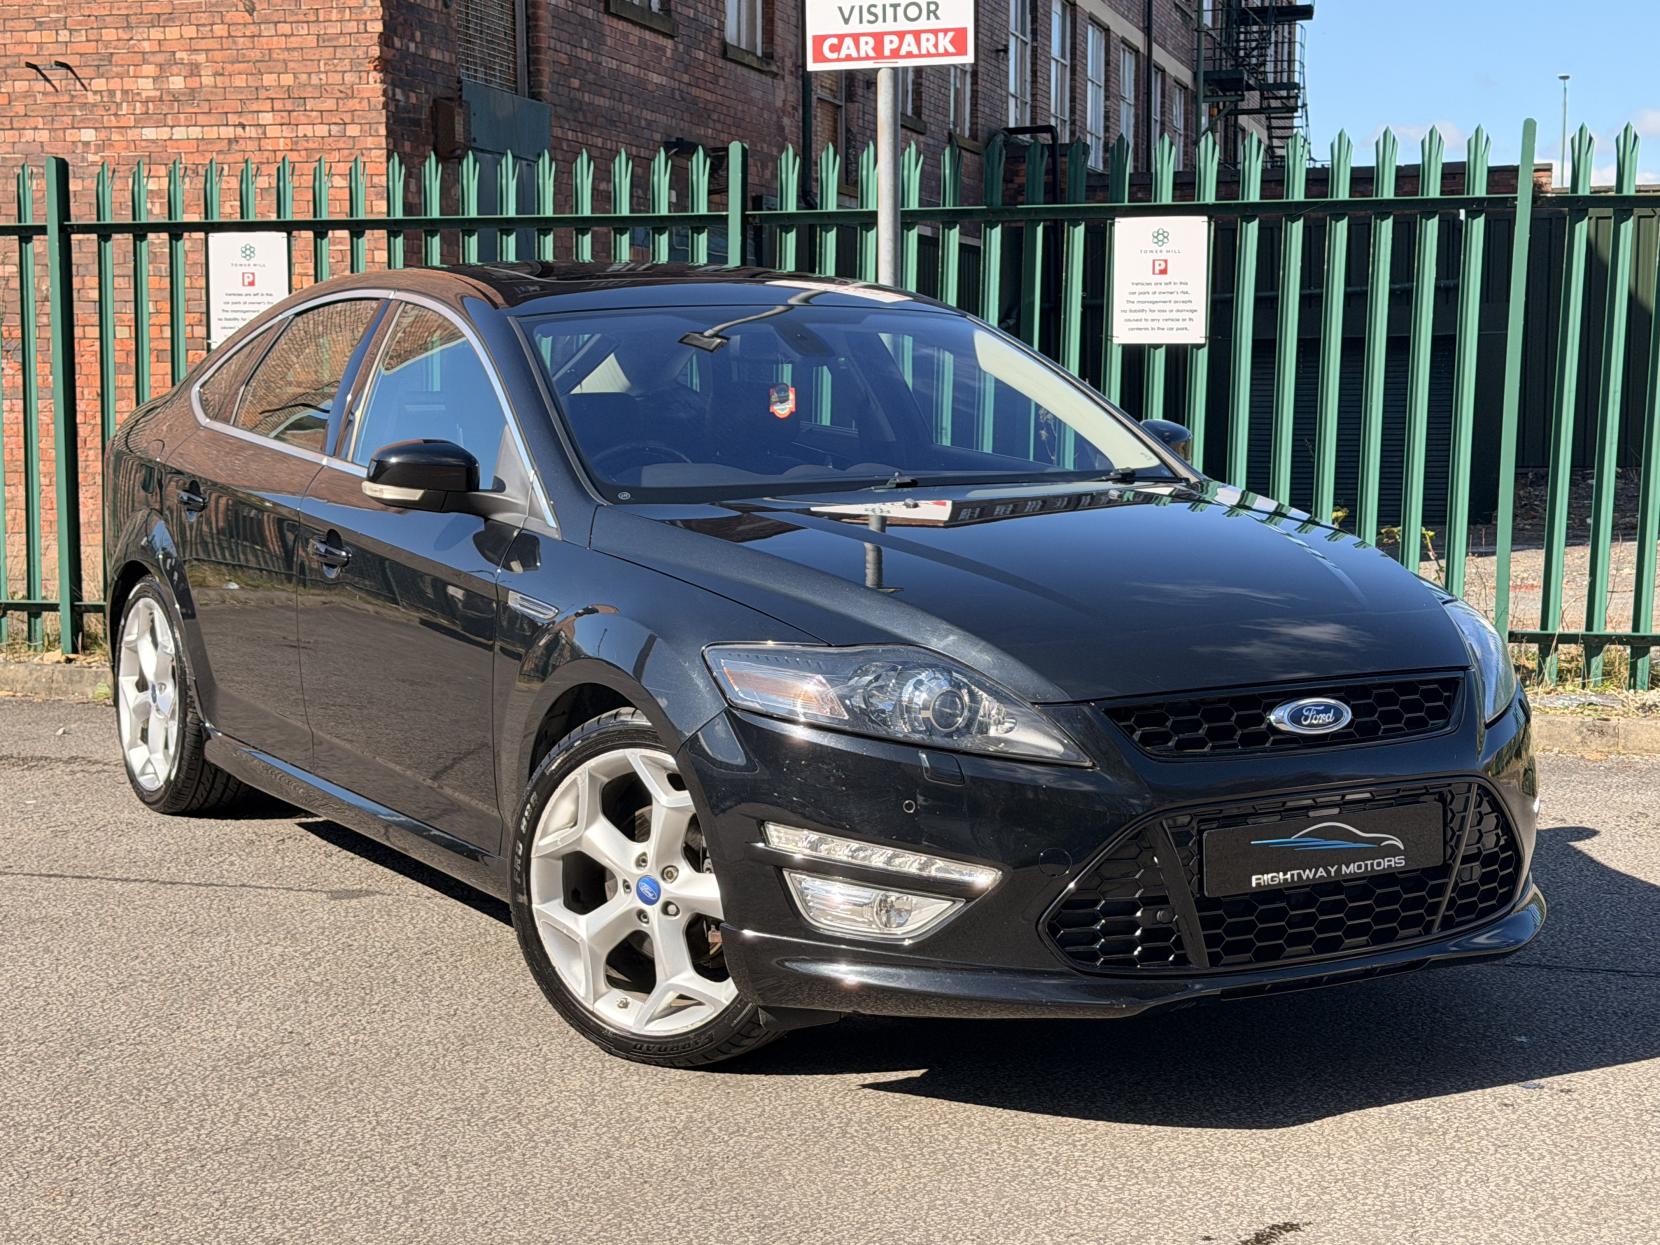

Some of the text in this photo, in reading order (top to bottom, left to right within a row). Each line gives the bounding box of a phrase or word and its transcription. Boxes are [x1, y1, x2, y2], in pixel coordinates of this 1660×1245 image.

[837, 1, 941, 25] VISITOR
[822, 32, 957, 60] CAR PARK
[1301, 706, 1335, 725] Ford
[1251, 855, 1406, 888] RIGHTWAY MOTORS
